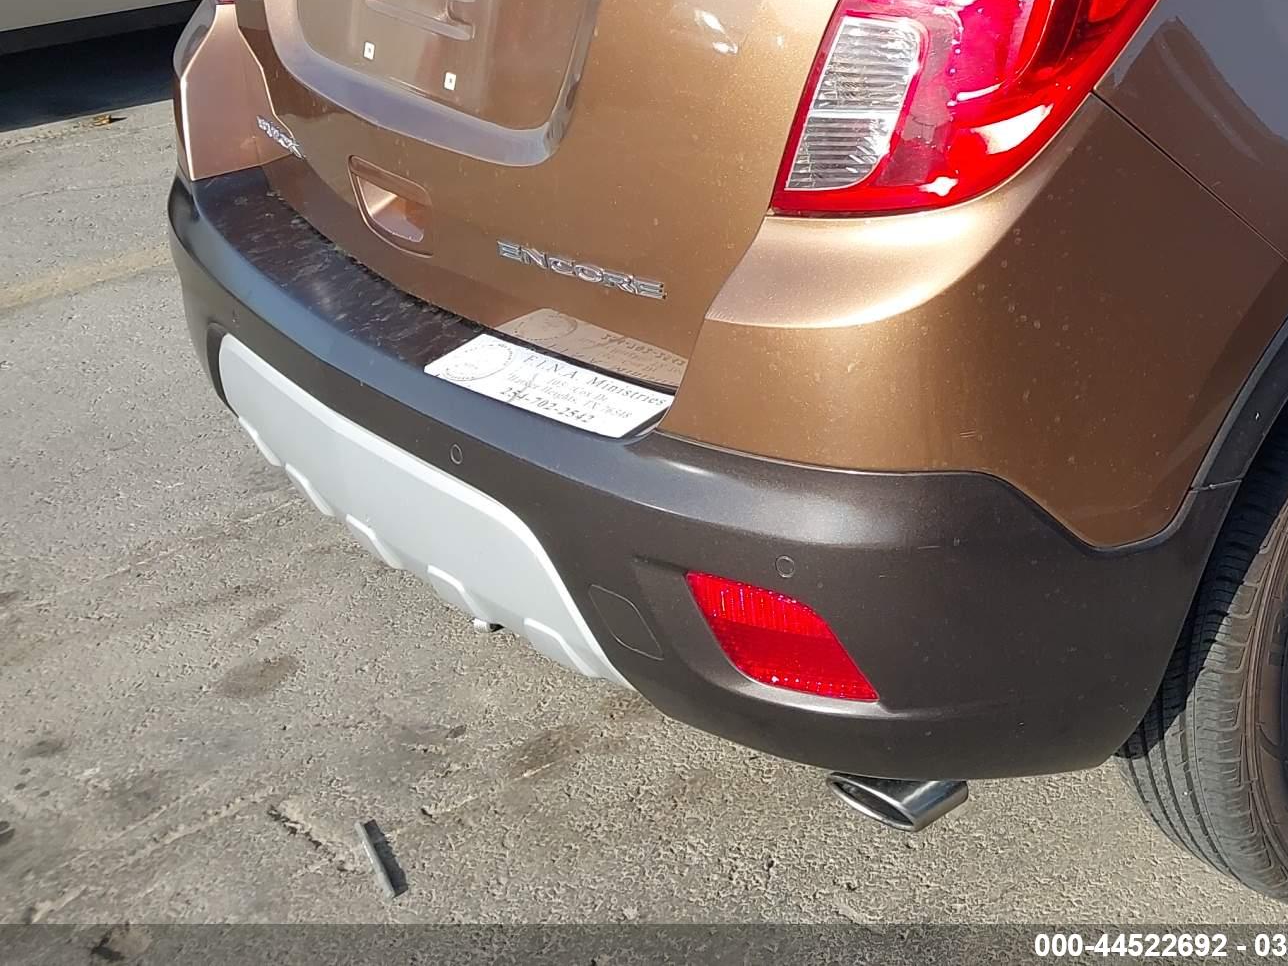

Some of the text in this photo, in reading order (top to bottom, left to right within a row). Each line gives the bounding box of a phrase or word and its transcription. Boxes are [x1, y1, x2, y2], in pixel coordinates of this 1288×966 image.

[496, 239, 667, 301] ENCORE
[499, 386, 595, 422] 254-702-2542
[585, 375, 667, 407] Ministries
